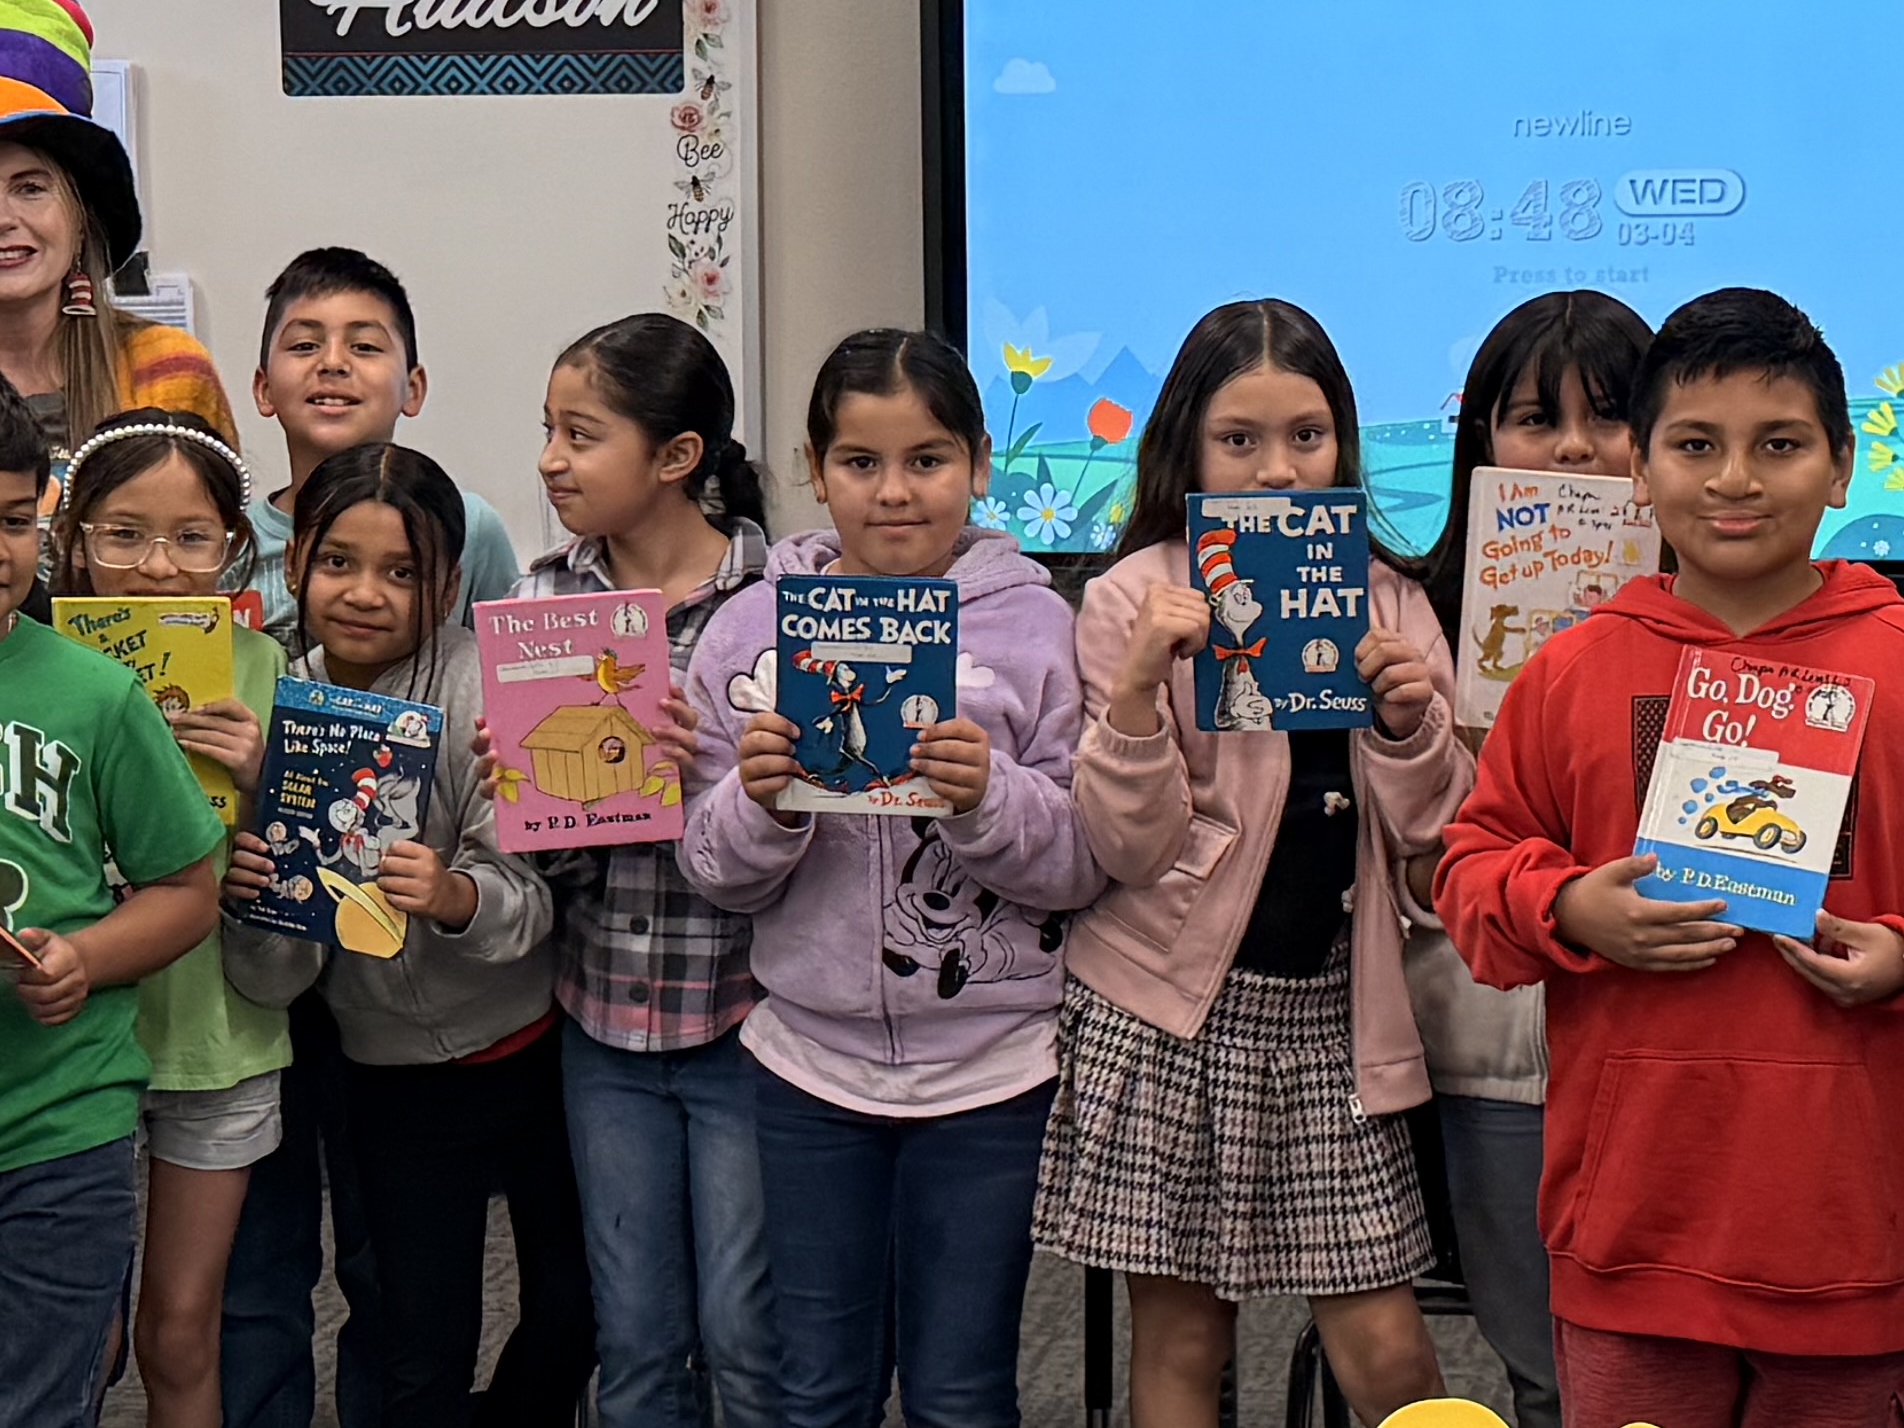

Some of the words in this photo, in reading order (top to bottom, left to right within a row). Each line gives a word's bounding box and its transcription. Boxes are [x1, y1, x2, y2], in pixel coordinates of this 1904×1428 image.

[1514, 111, 1632, 137] newline
[676, 135, 725, 167] Bee
[667, 202, 734, 236] Happy
[1399, 178, 1602, 243] 08:48
[1629, 179, 1726, 205] WED
[1618, 222, 1695, 246] 03-04
[1494, 268, 1560, 283] Press
[1566, 268, 1587, 283] to
[1597, 268, 1648, 282] start
[1499, 483, 1506, 503] I
[1511, 483, 1538, 501] Am
[1223, 515, 1272, 534] THE
[1278, 505, 1358, 537] CAT
[1496, 503, 1550, 532] NOT
[1306, 543, 1333, 561] IN
[1482, 530, 1544, 560] Going
[1549, 524, 1571, 542] to
[1297, 566, 1342, 584] THE
[1479, 564, 1518, 589] Get
[1522, 560, 1544, 580] up
[1543, 540, 1614, 573] Today!
[782, 590, 807, 605] THE
[808, 587, 856, 611] CAT
[856, 594, 870, 606] IN
[874, 596, 895, 608] THE
[897, 589, 951, 613] HAT
[1280, 586, 1365, 620] HAT
[68, 607, 131, 636] There's
[488, 615, 535, 636] The
[543, 609, 599, 631] Best
[781, 614, 872, 641] COMES
[880, 617, 952, 645] BACK
[517, 638, 572, 658] Nest
[1288, 692, 1319, 714] Dr.
[1319, 688, 1367, 714] Seuss
[1735, 674, 1795, 719] Dog.
[282, 721, 326, 737] There's
[329, 724, 346, 738] No
[350, 725, 380, 741] Place
[1702, 710, 1756, 747] Go!
[284, 739, 308, 754] Like
[312, 739, 352, 757] Space!
[880, 791, 902, 807] Dr.
[906, 791, 945, 809] Seuss
[524, 820, 541, 832] by
[585, 808, 652, 828] Eastman
[1655, 861, 1677, 882] by
